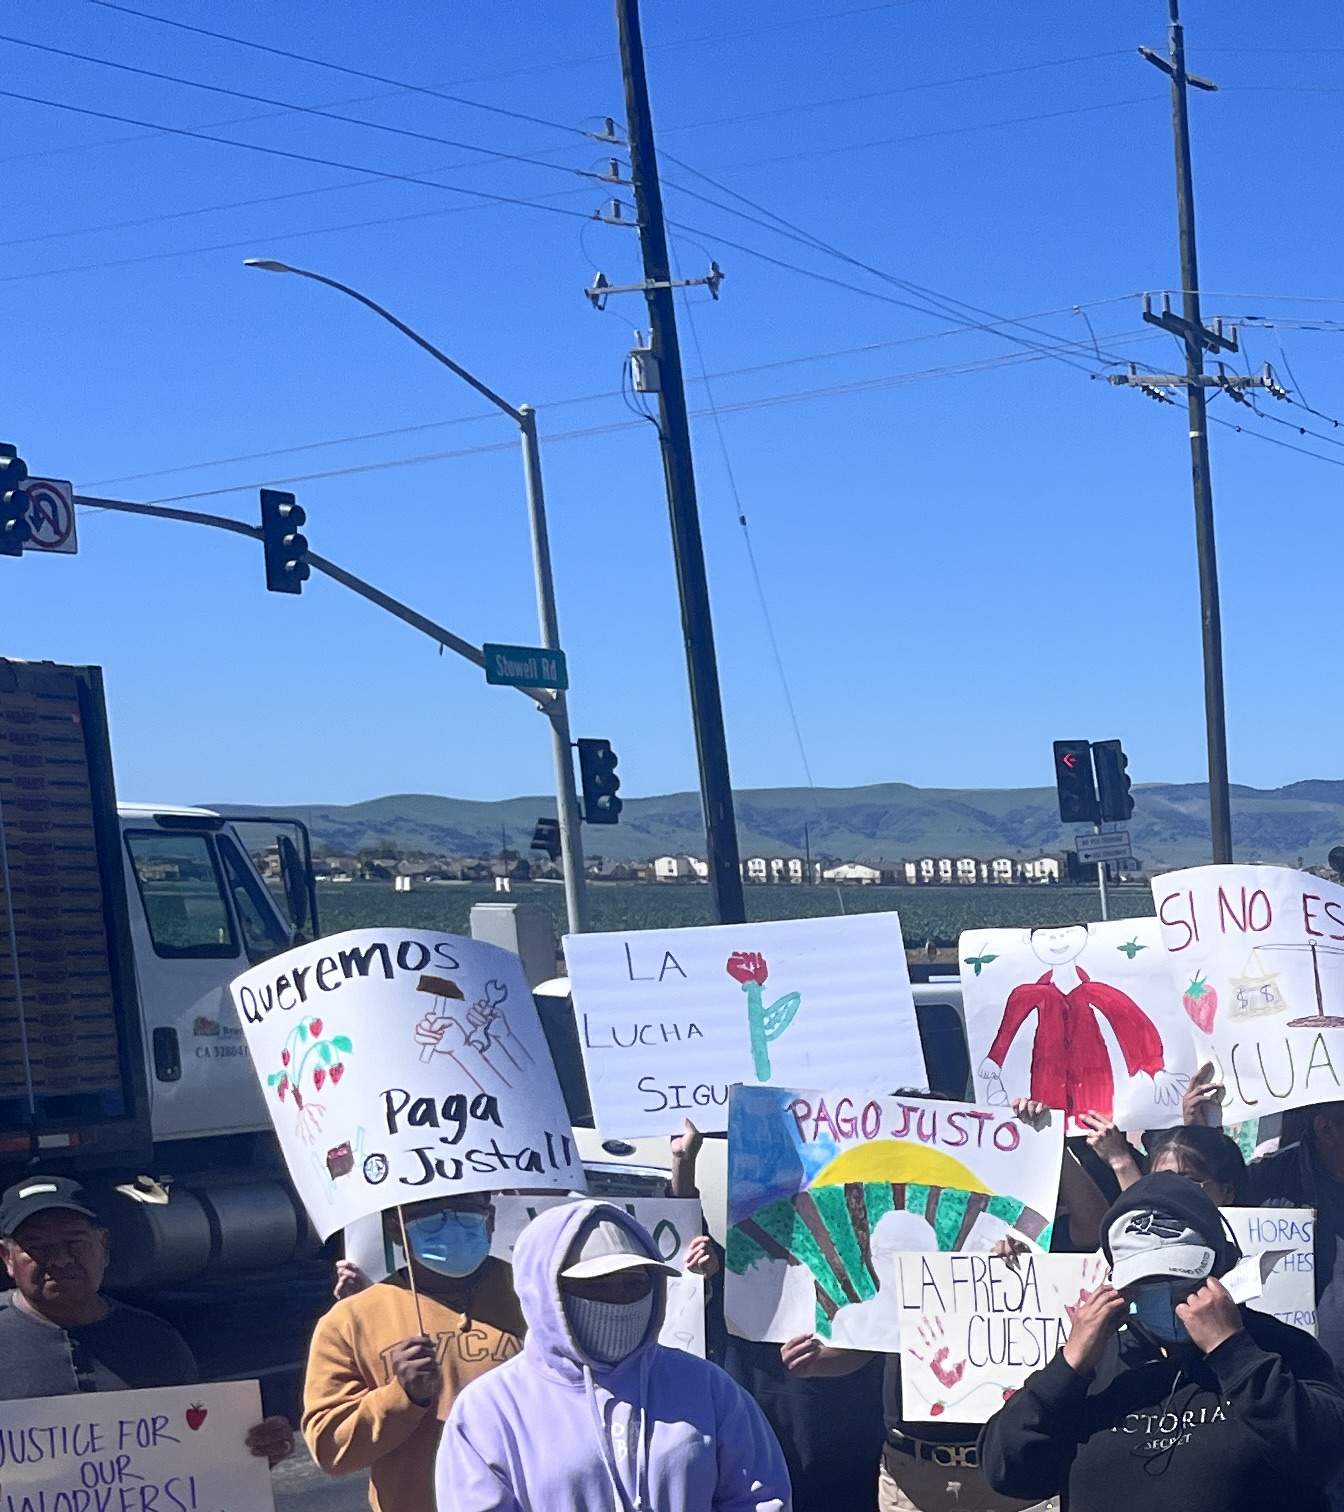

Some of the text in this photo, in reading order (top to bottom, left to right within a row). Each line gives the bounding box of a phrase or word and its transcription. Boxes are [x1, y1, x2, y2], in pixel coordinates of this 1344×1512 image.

[541, 657, 557, 680] Rd
[1159, 891, 1200, 952] SI
[1218, 885, 1273, 934] NO
[624, 942, 687, 982] LA
[582, 1013, 704, 1049] LUCHA
[637, 1077, 738, 1112] SIGU
[380, 1088, 502, 1144] Paga
[785, 1098, 1021, 1152] PAGO JUSTO
[1248, 1217, 1313, 1243] HORAS
[899, 1255, 1042, 1314] LA FRESA
[1273, 1310, 1316, 1326] TROS
[968, 1316, 1069, 1368] CUESTA
[0, 1415, 181, 1469] JUSTICE FOR
[80, 1454, 145, 1489] OUR
